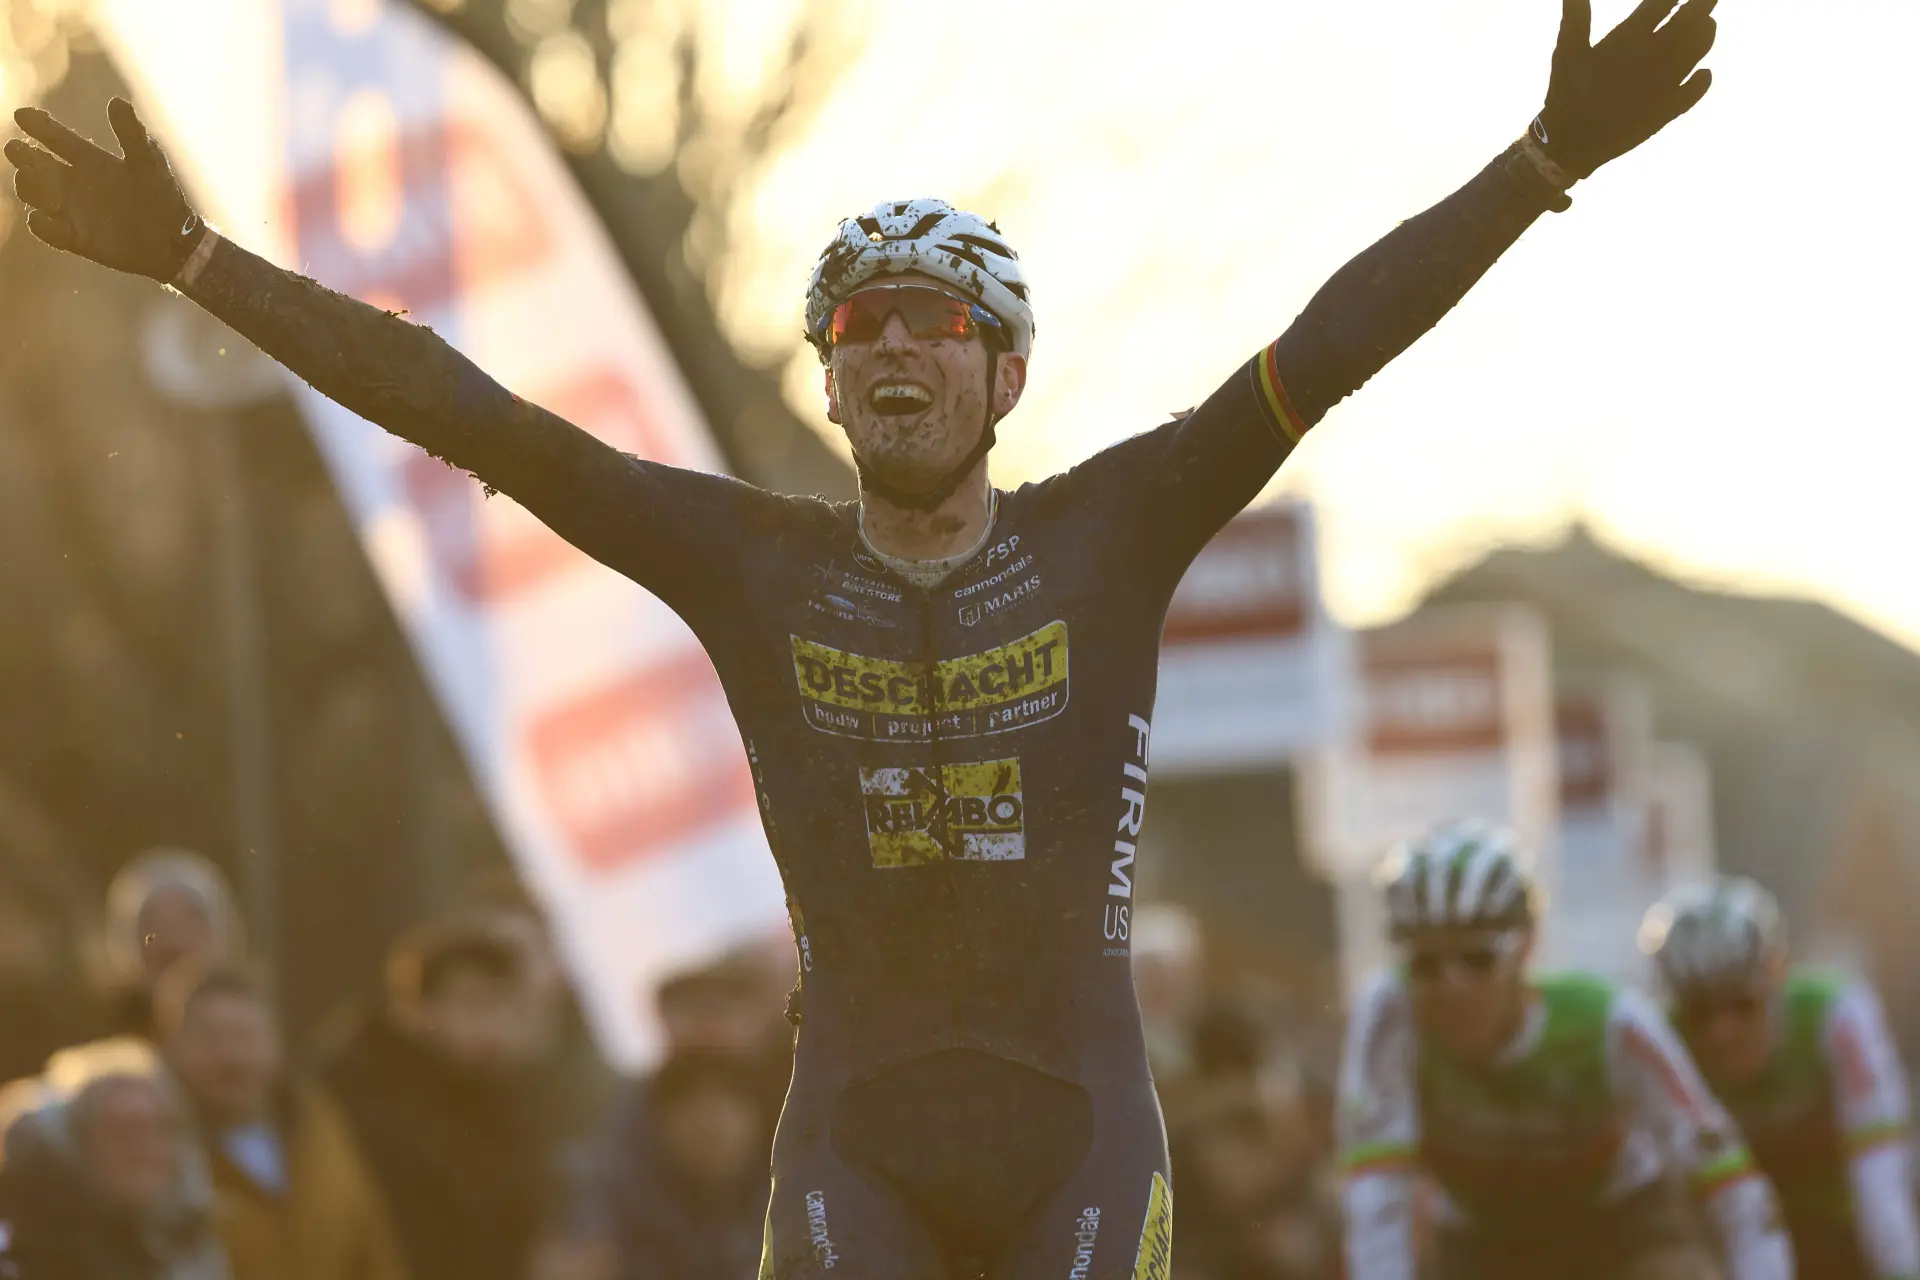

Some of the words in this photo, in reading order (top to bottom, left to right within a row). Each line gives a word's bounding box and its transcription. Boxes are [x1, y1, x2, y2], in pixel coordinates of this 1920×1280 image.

[986, 535, 1020, 567] FSP
[954, 554, 1033, 598] cannondale
[984, 574, 1041, 613] MARIS
[800, 639, 1060, 706] DESCHACHT
[989, 691, 1059, 727] partner
[1108, 713, 1149, 898] FIRM
[1104, 904, 1129, 940] US
